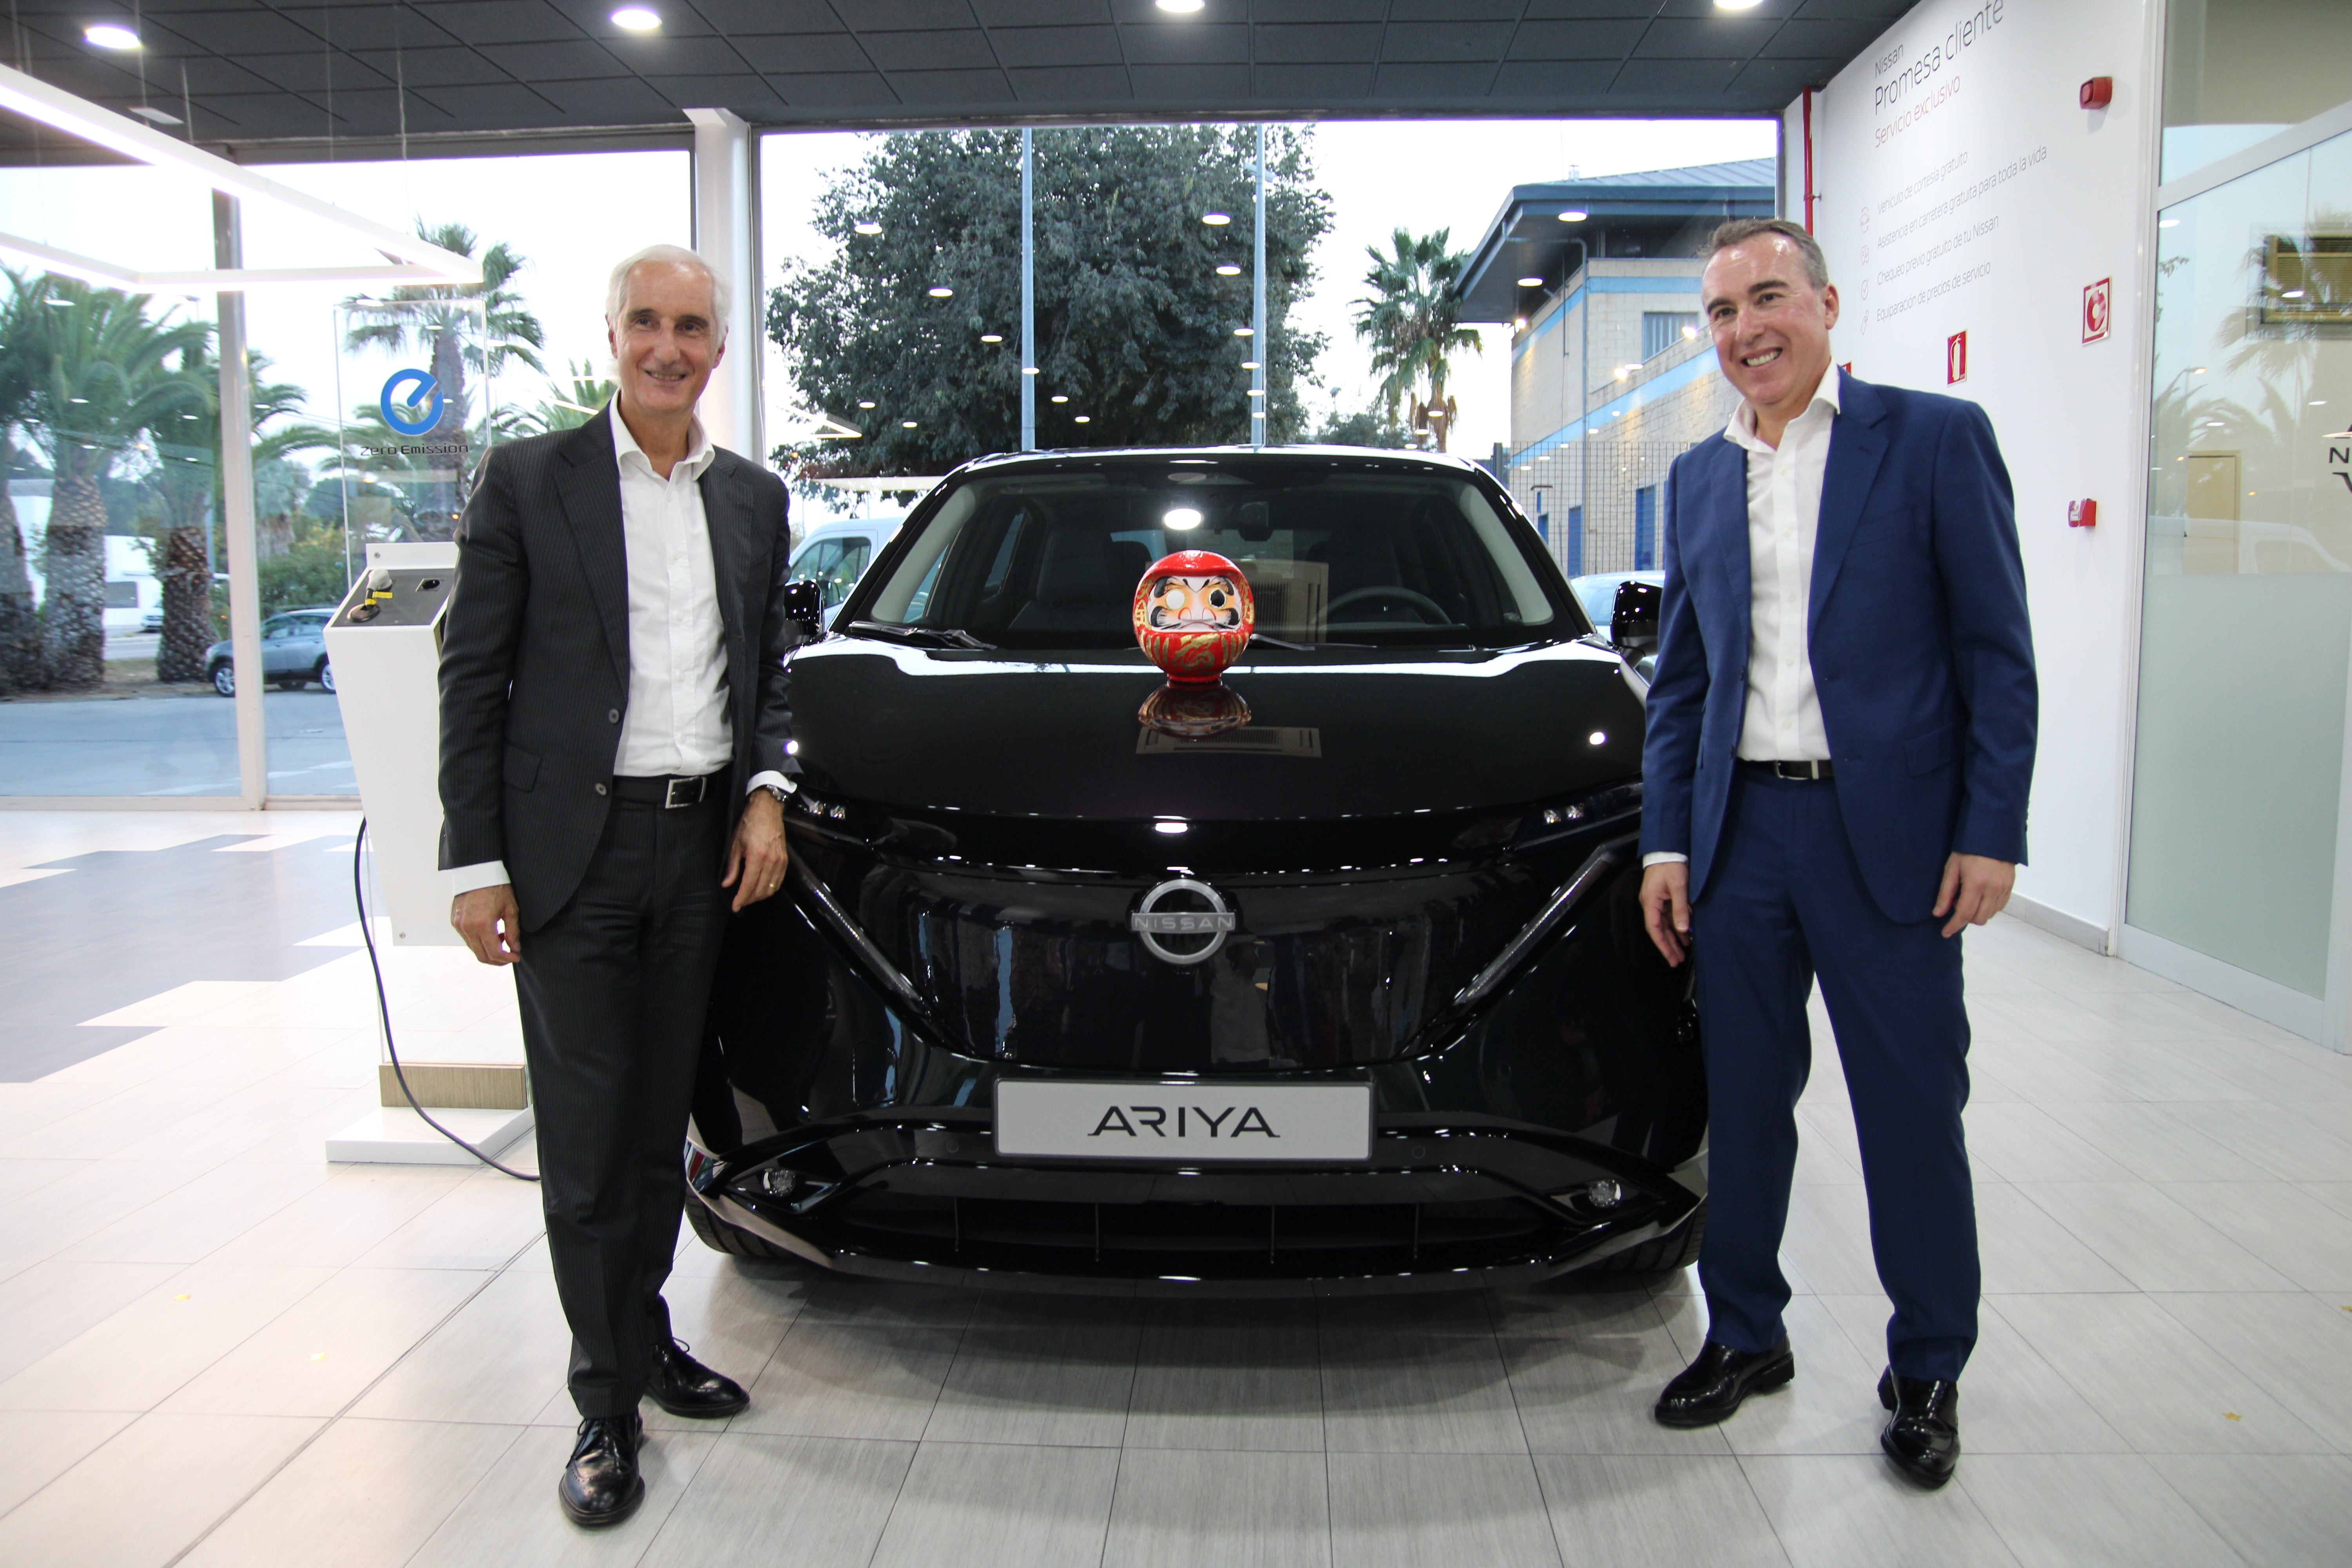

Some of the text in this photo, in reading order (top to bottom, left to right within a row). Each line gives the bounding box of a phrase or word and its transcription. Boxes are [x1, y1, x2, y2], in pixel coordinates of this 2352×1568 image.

[1875, 0, 2003, 116] Promesa cliente
[1875, 44, 1904, 78] Nissan
[1875, 76, 1960, 148] Servicio exclusivo
[1877, 151, 1968, 215] Vehículo de cortesía gratuito
[1877, 145, 2047, 250] Asistencia en carretera gratuita para toda la vida
[1877, 215, 1999, 285] Chequeo previo gratuito de tu Nissan
[1877, 260, 1991, 323] Equiparación de precios de servicio
[401, 443, 469, 455] Emission
[1134, 916, 1232, 931] NISSAN
[1087, 1105, 1281, 1138] ARIYA
